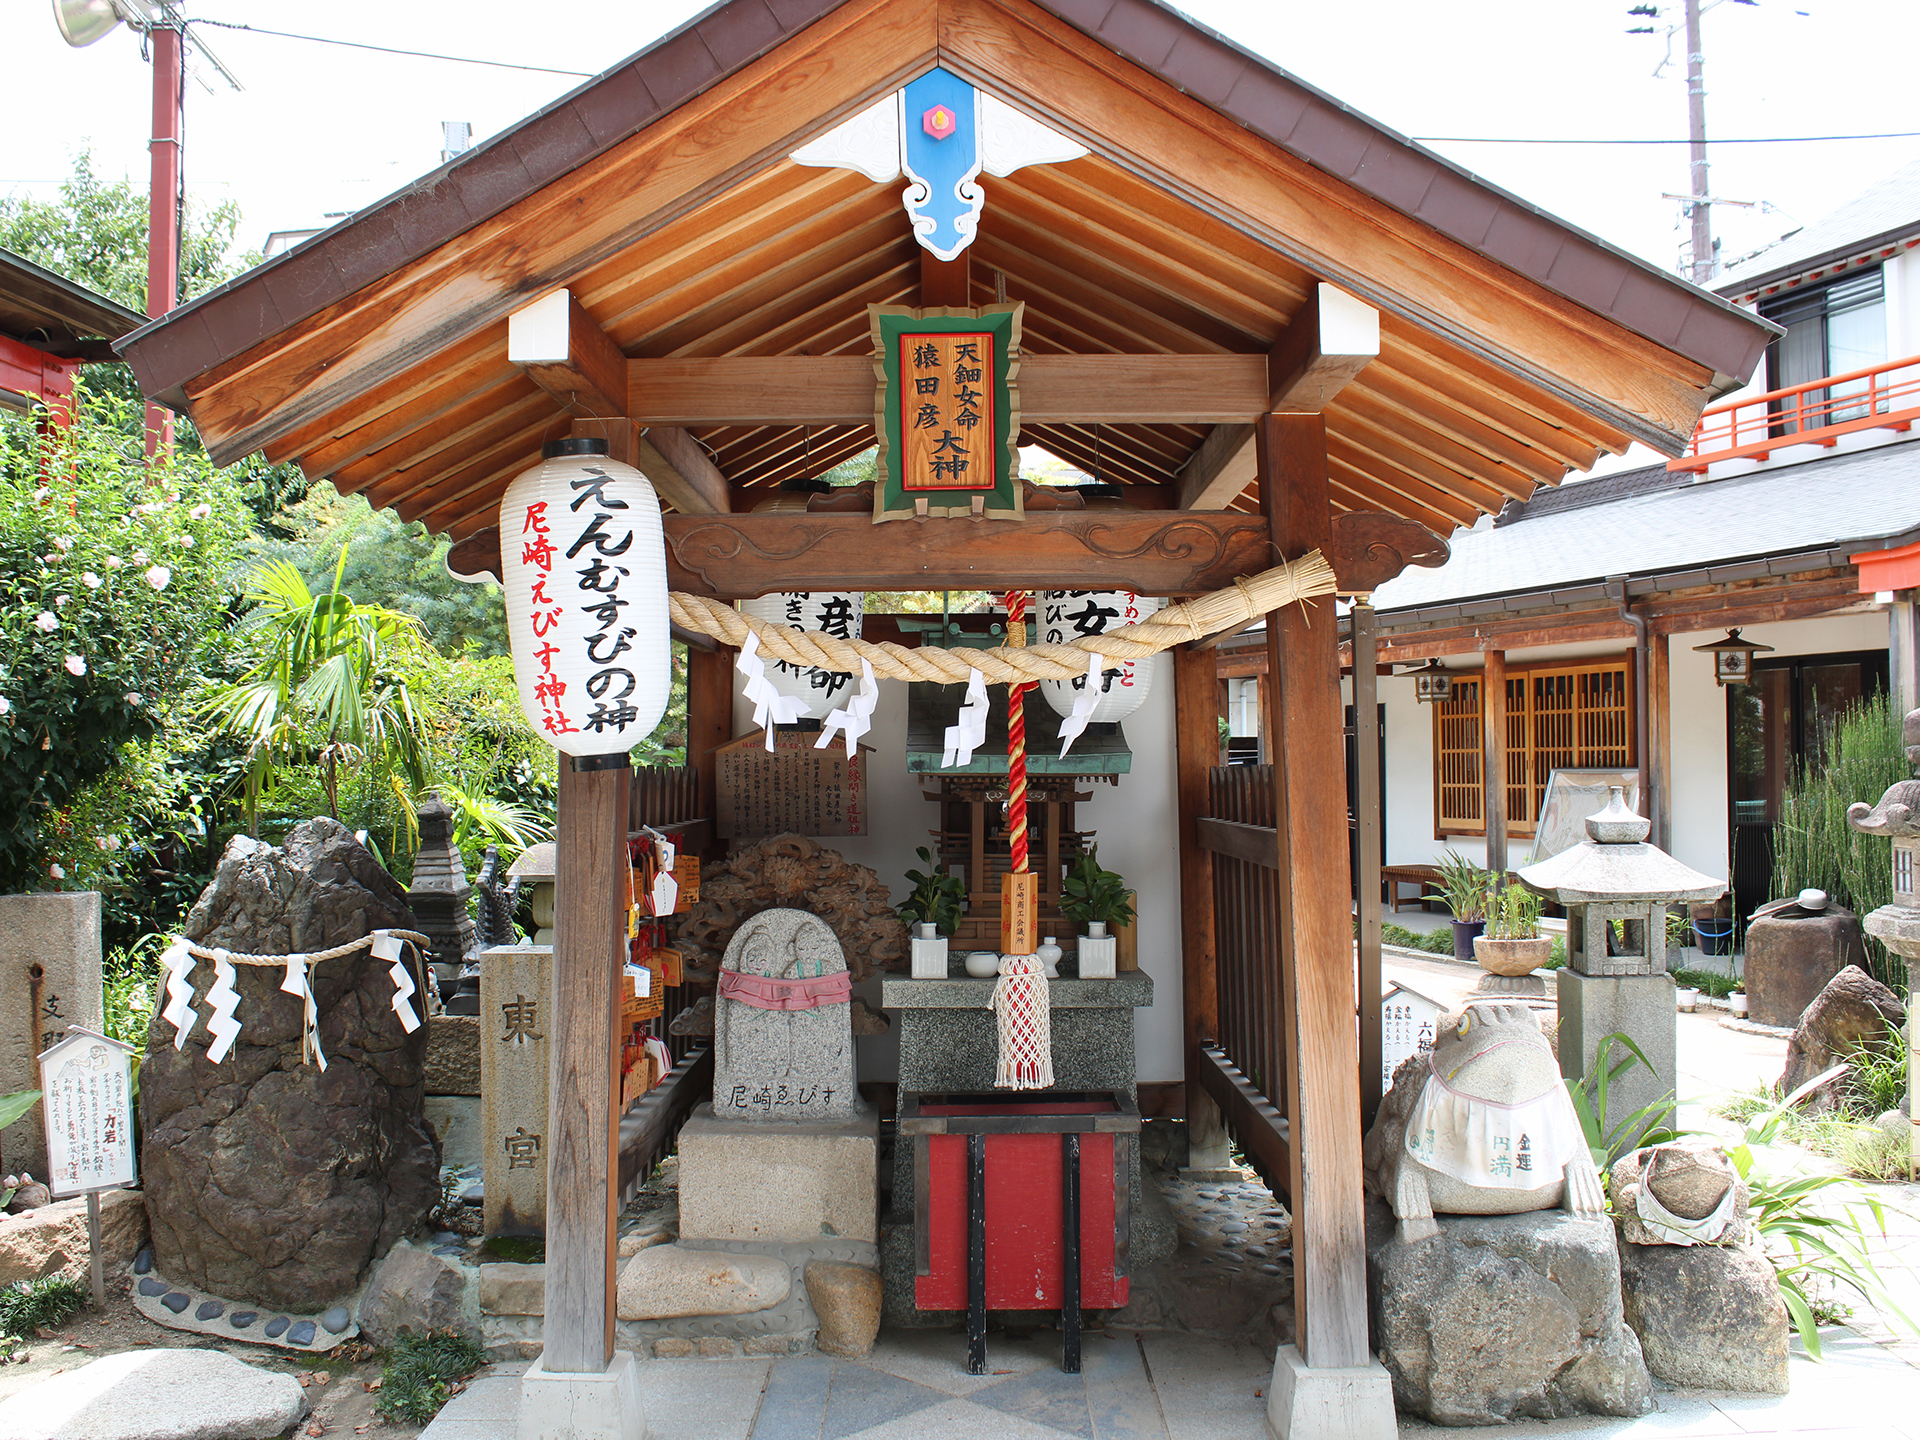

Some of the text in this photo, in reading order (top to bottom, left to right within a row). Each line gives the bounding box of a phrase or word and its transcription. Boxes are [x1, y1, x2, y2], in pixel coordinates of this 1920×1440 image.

[912, 342, 942, 430] 猿田彦
[928, 428, 971, 481] 大神
[521, 500, 580, 737] 尼崎えびす神社
[565, 467, 639, 734] えんむすびの神
[500, 993, 545, 1170] 東宮
[727, 1084, 836, 1111] 尼崎ゑびす
[1489, 1134, 1512, 1179] 円満
[1515, 1132, 1533, 1172] 金運
